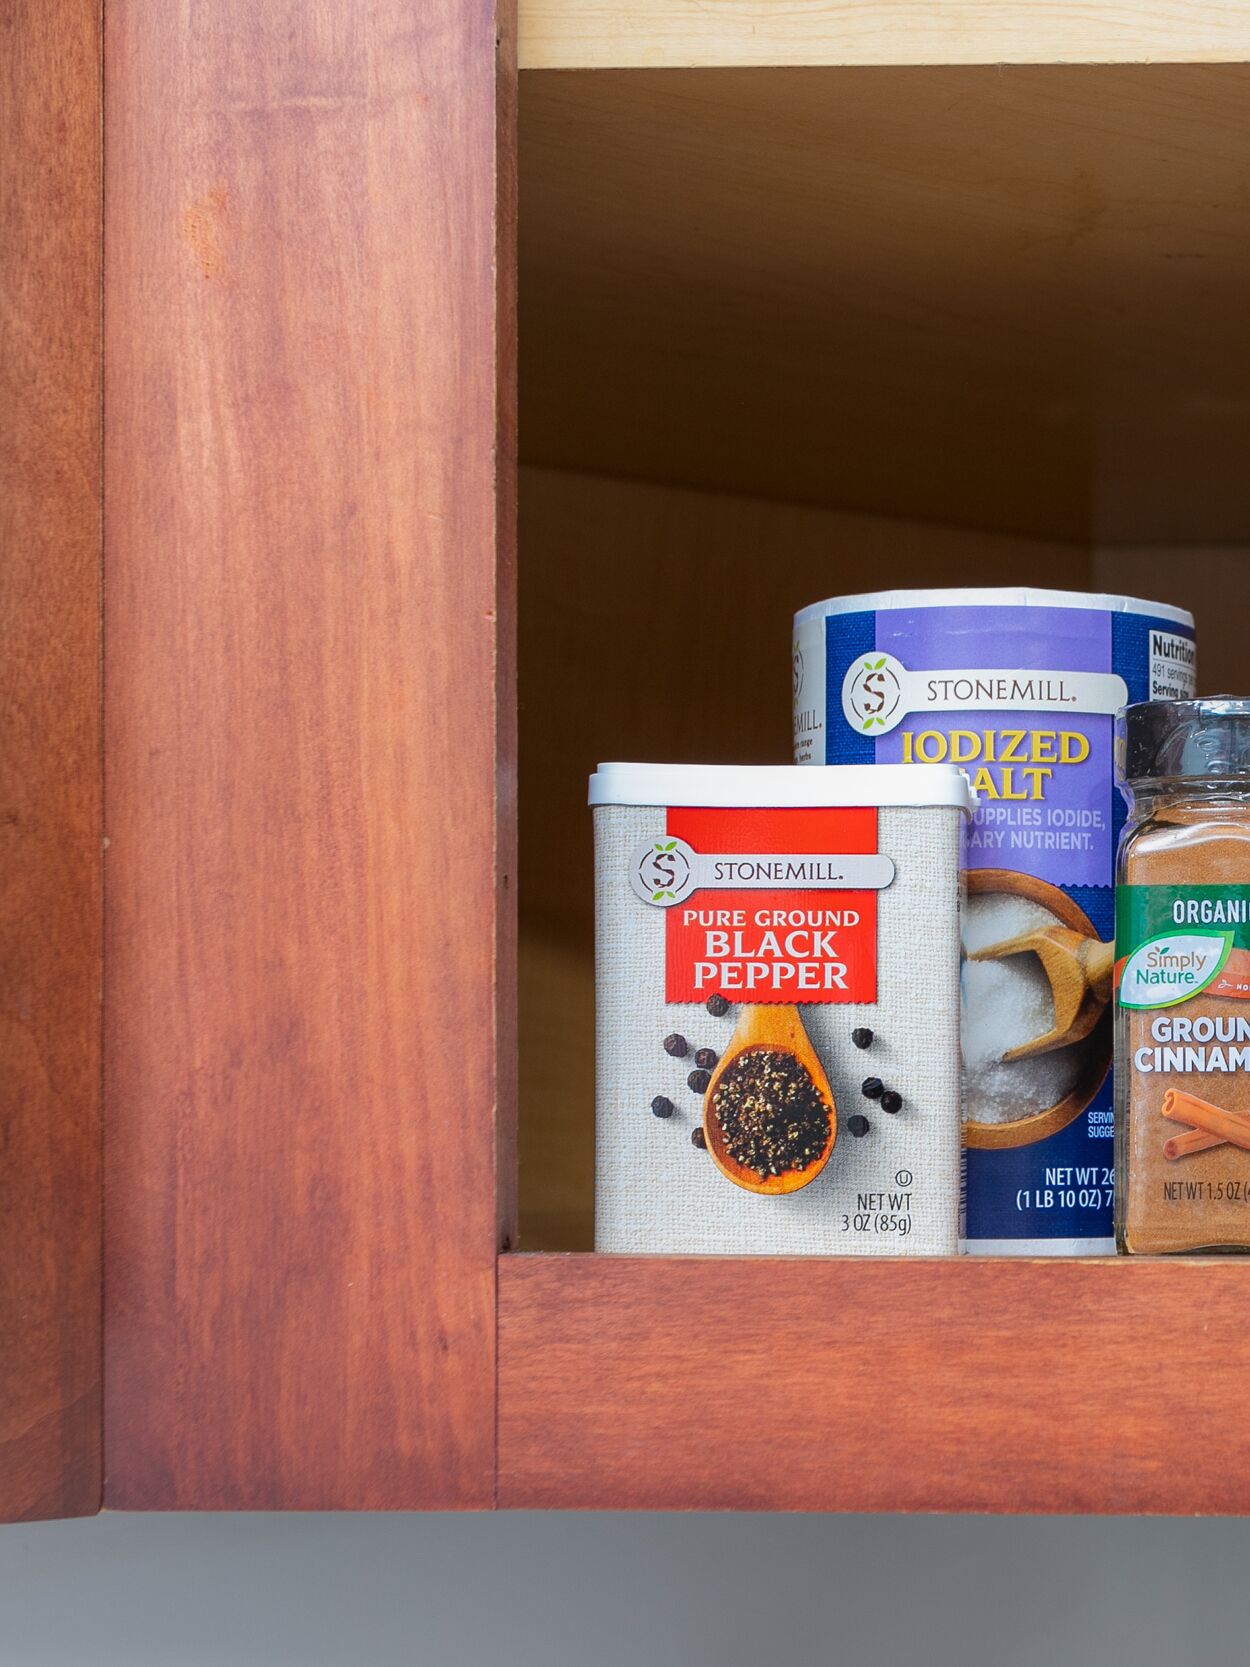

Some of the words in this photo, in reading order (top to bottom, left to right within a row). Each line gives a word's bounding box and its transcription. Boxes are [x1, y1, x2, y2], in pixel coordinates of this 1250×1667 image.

[1152, 663, 1165, 678] 491
[1152, 681, 1178, 698] Serving
[902, 730, 1090, 764] IODIZED
[972, 767, 1053, 800] ALT
[973, 807, 1042, 828] UPPLIES
[1047, 808, 1106, 830] IODIDE,
[970, 830, 1006, 848] ARY
[1010, 832, 1094, 850] NUTRIENT.
[682, 910, 745, 927] PURE
[754, 910, 860, 928] GROUND
[704, 930, 839, 958] BLACK
[1146, 950, 1206, 972] Simply
[693, 962, 848, 990] PEPPER
[1088, 1111, 1114, 1124] SERVIN
[1088, 1126, 1114, 1138] SUGGE
[1046, 1167, 1074, 1186] NET
[1075, 1167, 1099, 1186] WT
[1016, 1188, 1030, 1212] (1
[1036, 1190, 1054, 1208] LB
[1058, 1190, 1076, 1208] 10
[1078, 1188, 1102, 1210] OZ)
[1163, 1182, 1184, 1200] NET
[1186, 1182, 1203, 1200] WT
[1206, 1182, 1224, 1200] 1.5
[1226, 1182, 1240, 1200] OZ
[857, 1194, 886, 1211] NET
[888, 1194, 912, 1211] WT
[841, 1214, 849, 1232] 3
[853, 1214, 872, 1232] OZ
[874, 1214, 912, 1236] (85g)
